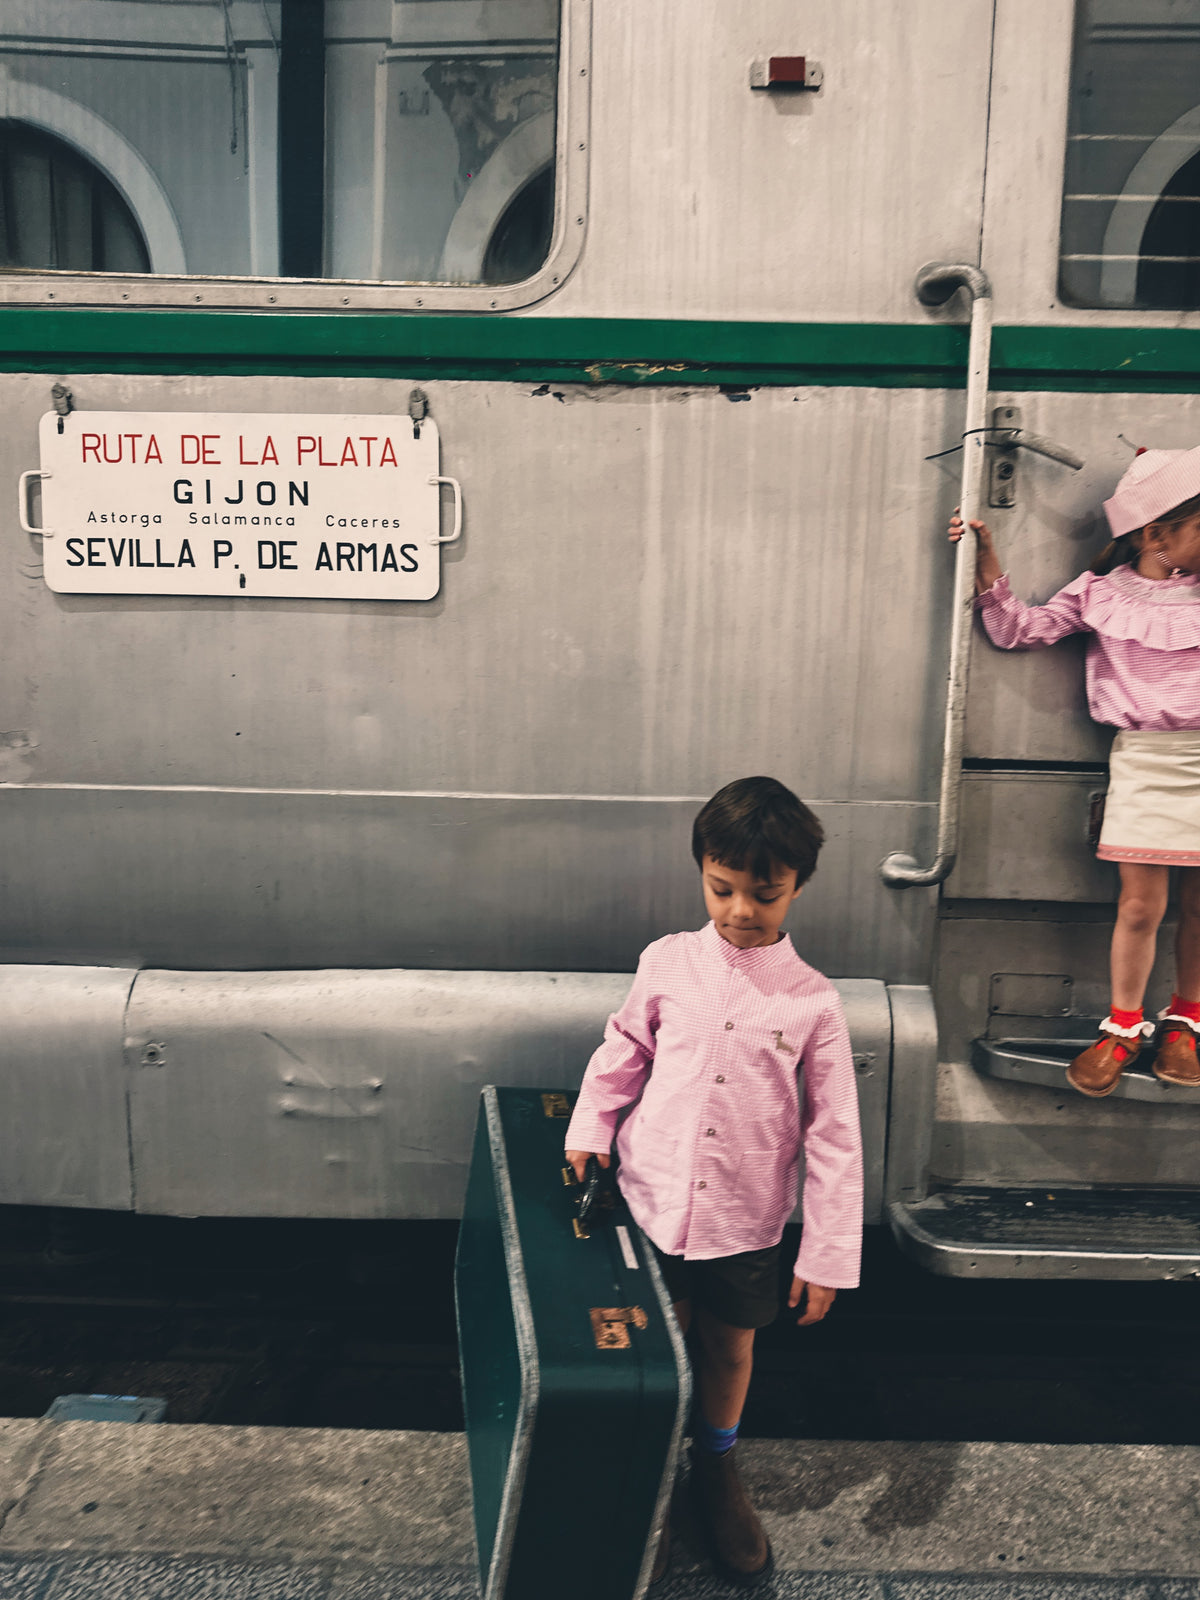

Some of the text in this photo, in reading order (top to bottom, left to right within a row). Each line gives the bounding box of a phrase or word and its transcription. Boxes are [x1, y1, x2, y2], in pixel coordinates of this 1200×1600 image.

[82, 434, 397, 467] RUTA DE LA PLATA
[174, 479, 308, 506] GIJON
[87, 511, 399, 528] Astorga Salamanca Caceres
[66, 538, 418, 572] SEVILLA P. DE ARMAS
